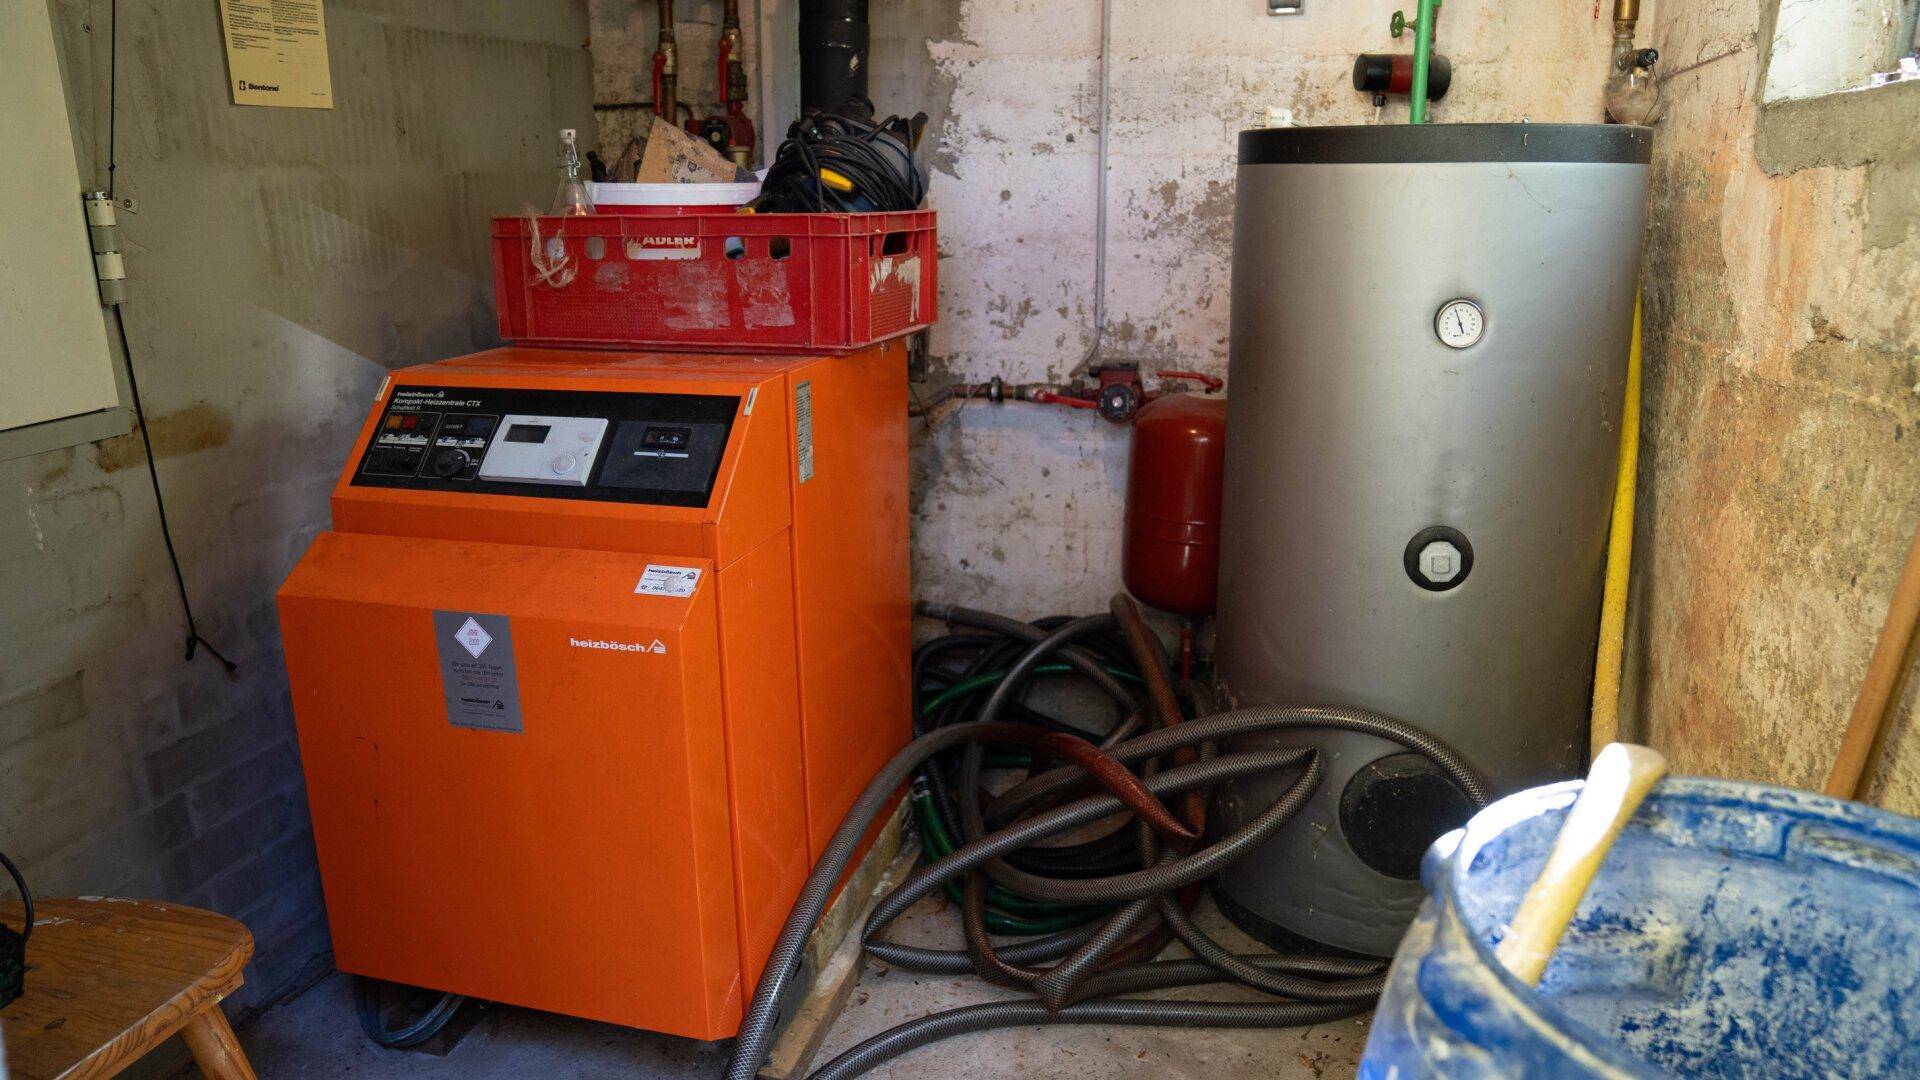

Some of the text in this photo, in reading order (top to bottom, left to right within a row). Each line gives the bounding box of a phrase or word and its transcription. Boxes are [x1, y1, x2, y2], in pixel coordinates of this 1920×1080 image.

[248, 83, 279, 92] Bentone
[393, 397, 465, 406] Kompakt-Heizzentrale
[570, 637, 645, 652] heizbösch
